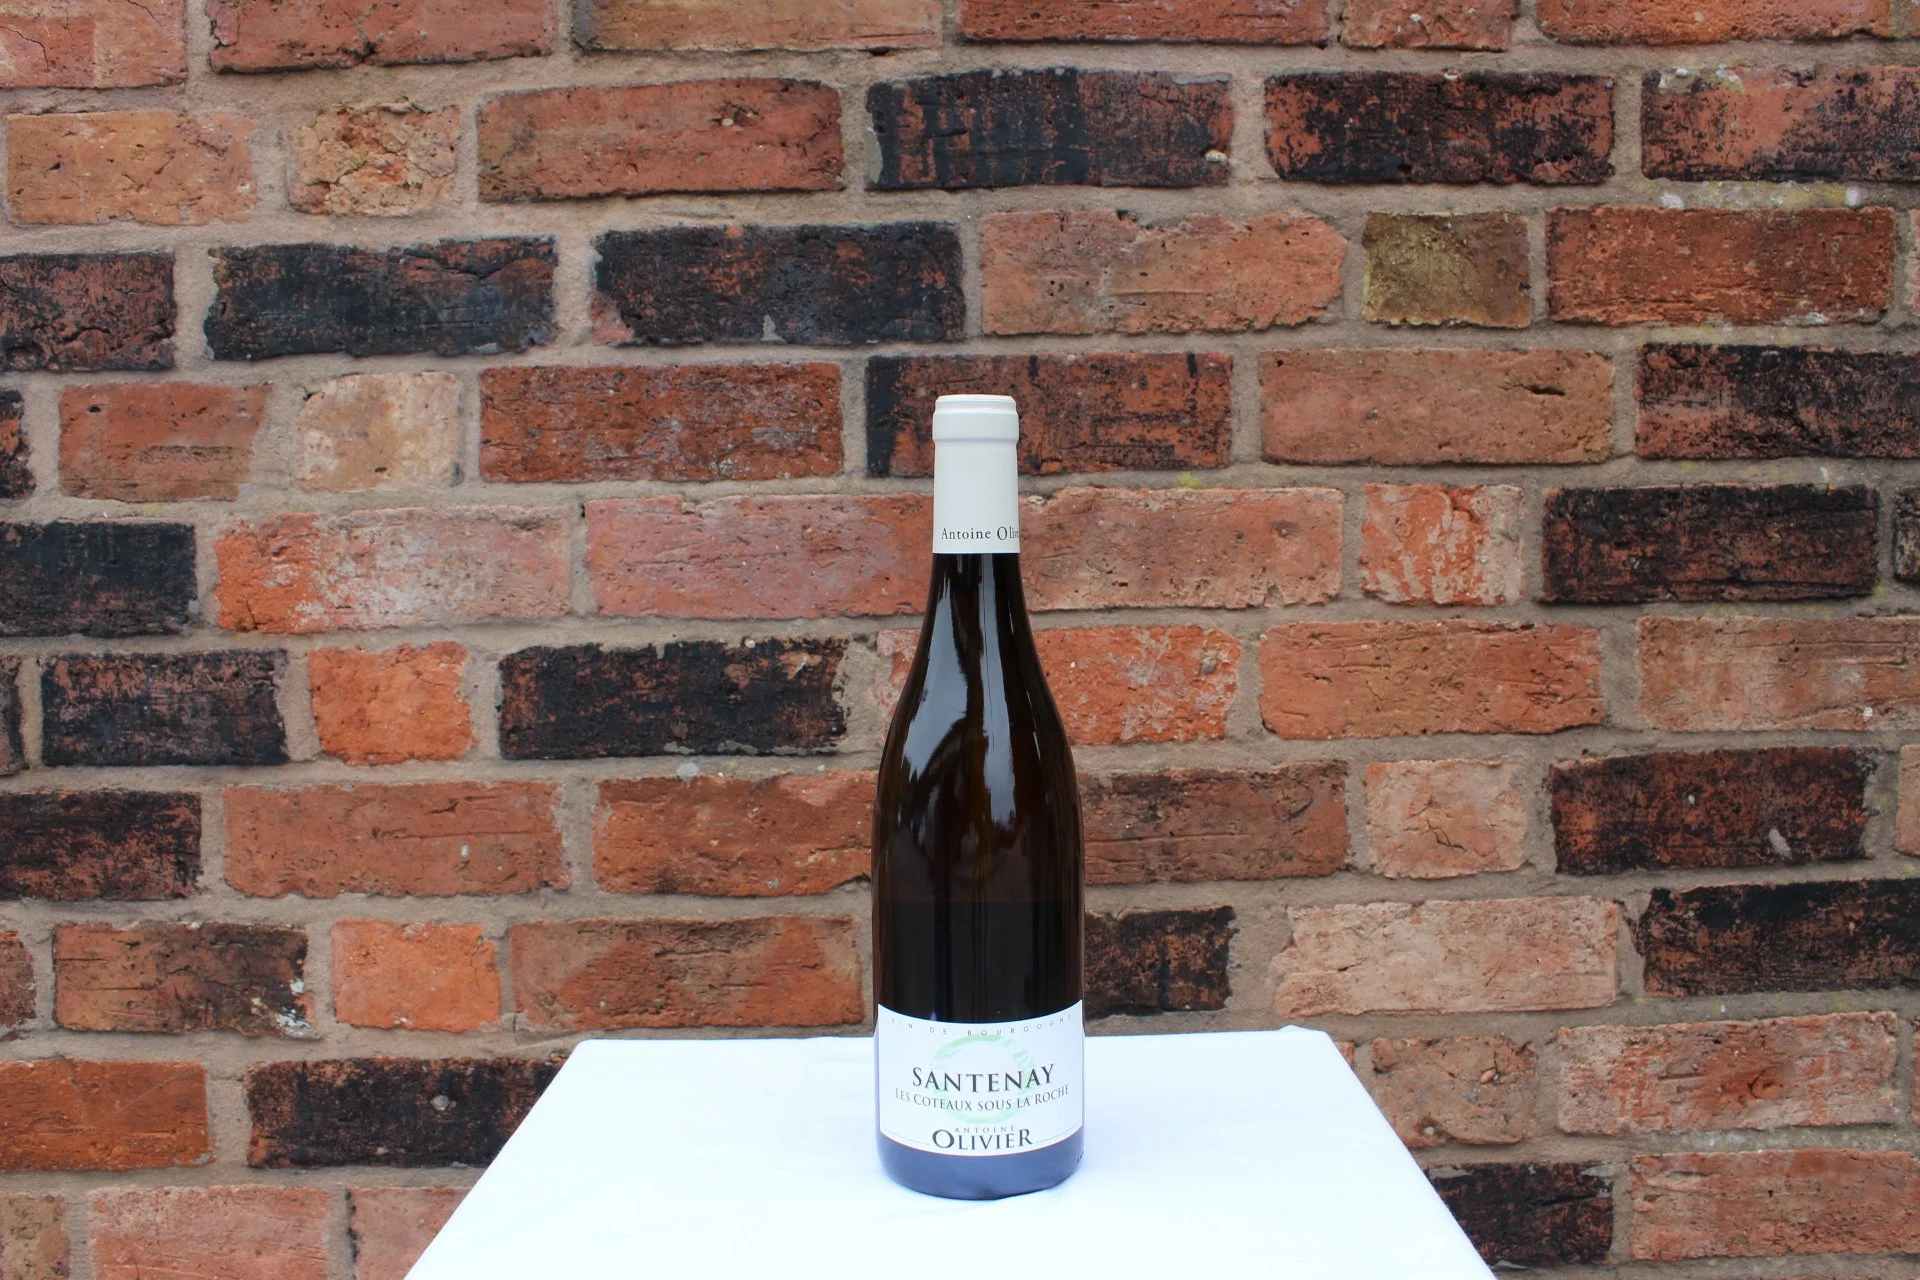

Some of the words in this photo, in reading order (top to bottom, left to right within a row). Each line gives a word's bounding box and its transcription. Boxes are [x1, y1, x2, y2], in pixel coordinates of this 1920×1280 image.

[941, 528, 991, 539] Antoine
[912, 1064, 1055, 1093] SANTENAY
[895, 1088, 910, 1102] LES
[914, 1095, 973, 1111] COTEAUX
[977, 1100, 1012, 1111] SOUS
[1016, 1098, 1030, 1108] LA
[1035, 1084, 1070, 1104] ROCHE
[932, 1129, 1033, 1150] OLIVIER
[955, 1125, 1015, 1133] ANTOINE
